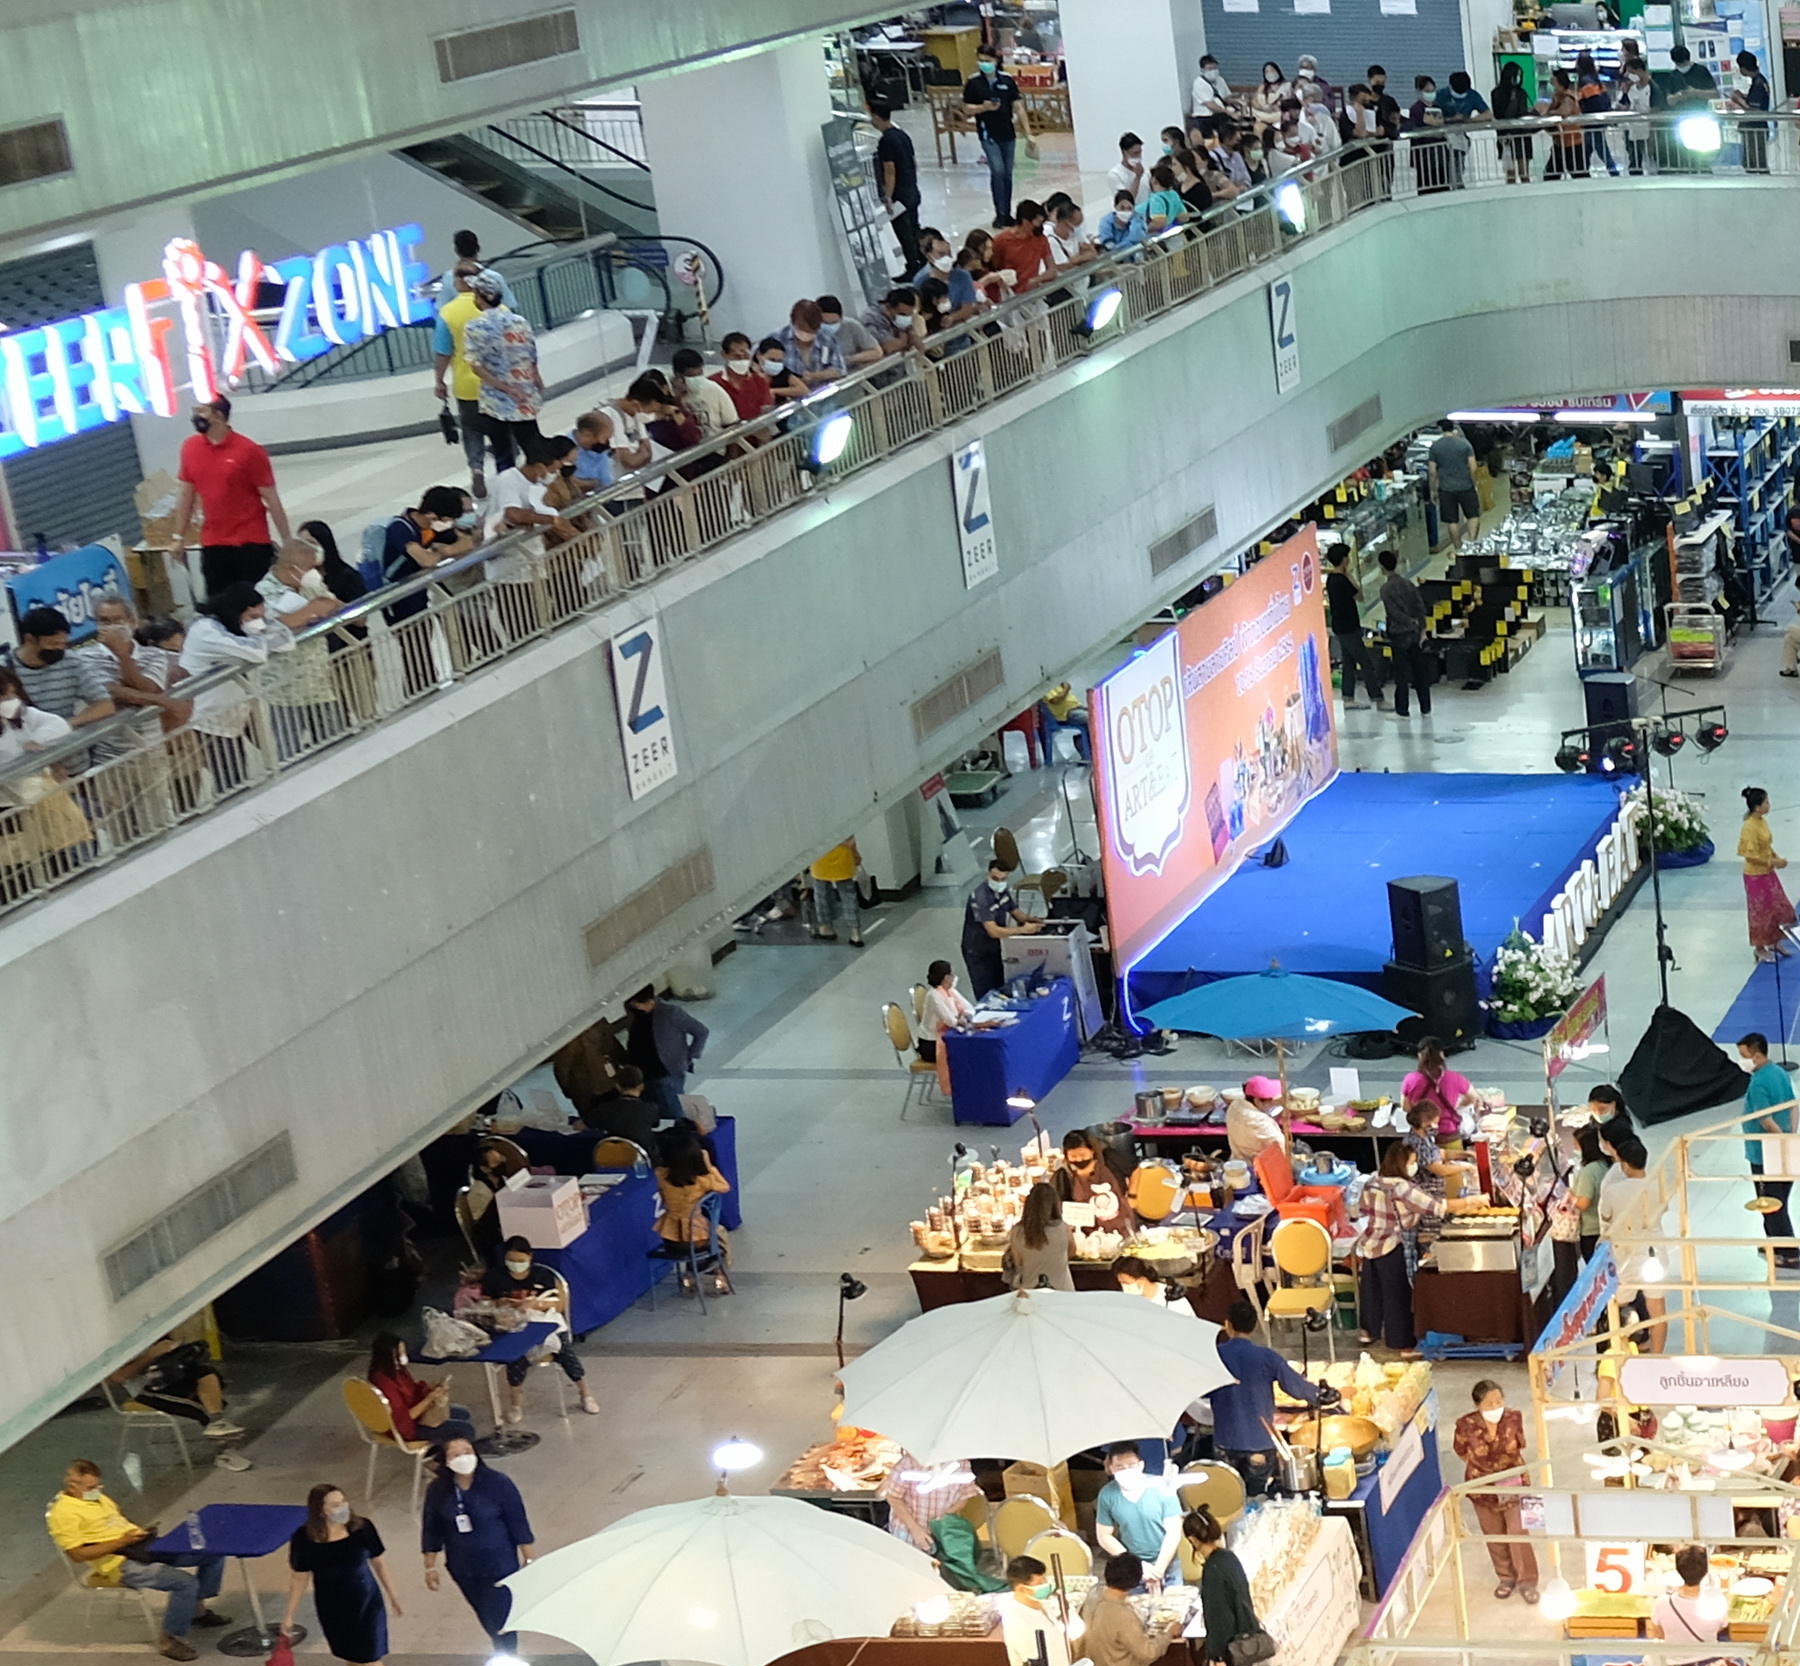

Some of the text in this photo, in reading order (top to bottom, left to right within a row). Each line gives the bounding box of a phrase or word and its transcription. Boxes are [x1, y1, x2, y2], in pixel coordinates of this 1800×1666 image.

[263, 223, 436, 366] ZONE
[1279, 354, 1297, 378] ZEER
[966, 538, 994, 567] ZEER
[1117, 675, 1174, 765] OTOP
[632, 736, 670, 775] ZEER
[1594, 1547, 1632, 1594] 5
